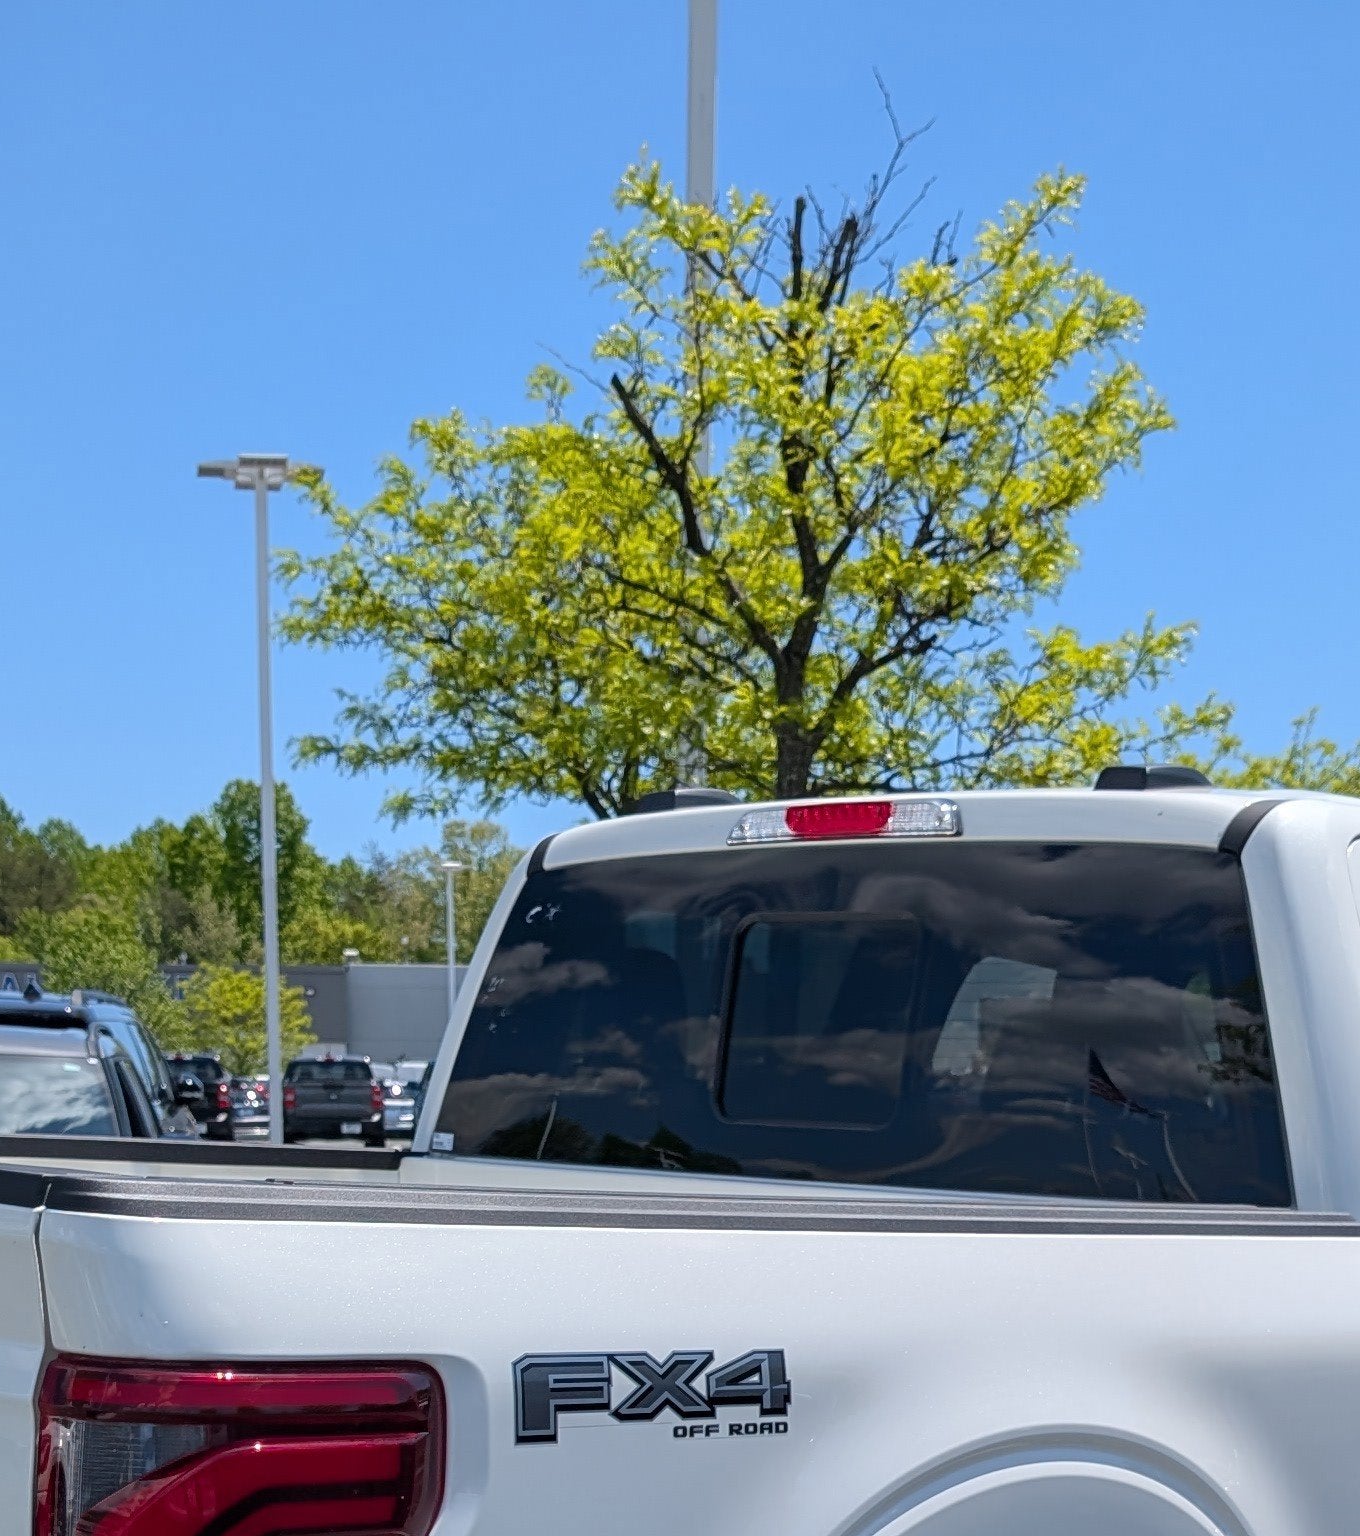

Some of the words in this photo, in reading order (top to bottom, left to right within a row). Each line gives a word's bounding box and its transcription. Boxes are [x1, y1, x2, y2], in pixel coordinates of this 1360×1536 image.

[511, 1349, 791, 1445] FX4
[673, 1423, 720, 1439] OFF
[728, 1421, 789, 1436] ROAD
